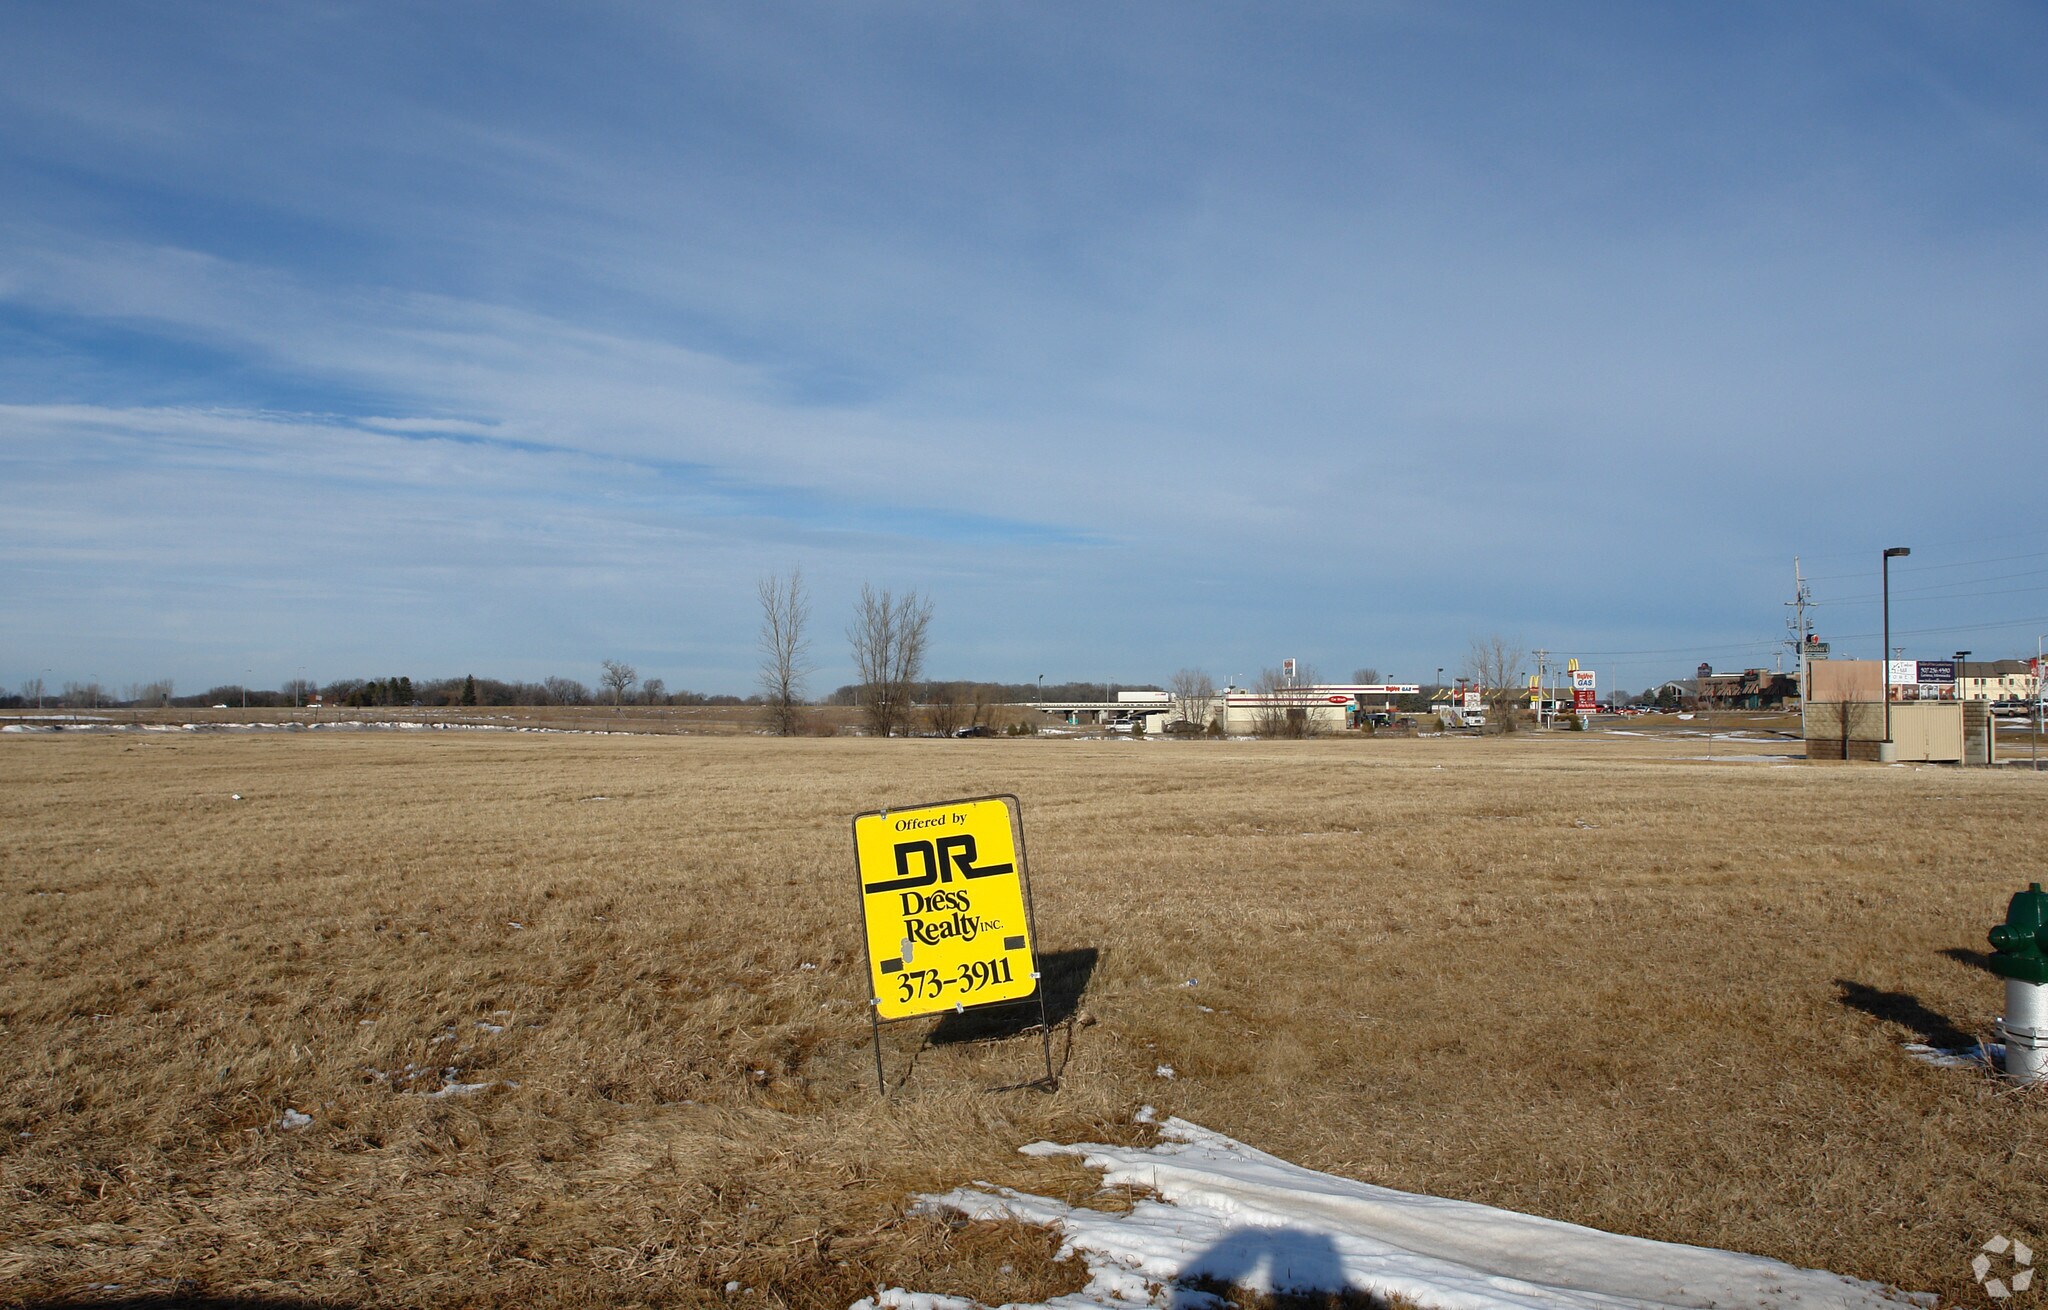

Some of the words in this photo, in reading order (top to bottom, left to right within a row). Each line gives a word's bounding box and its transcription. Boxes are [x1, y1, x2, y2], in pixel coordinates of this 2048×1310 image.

[895, 814, 946, 832] Offered
[952, 813, 967, 825] by
[899, 889, 971, 917] Dress
[904, 912, 980, 946] Realty
[980, 919, 1004, 932] INC.
[897, 956, 1014, 1003] 373-3911
